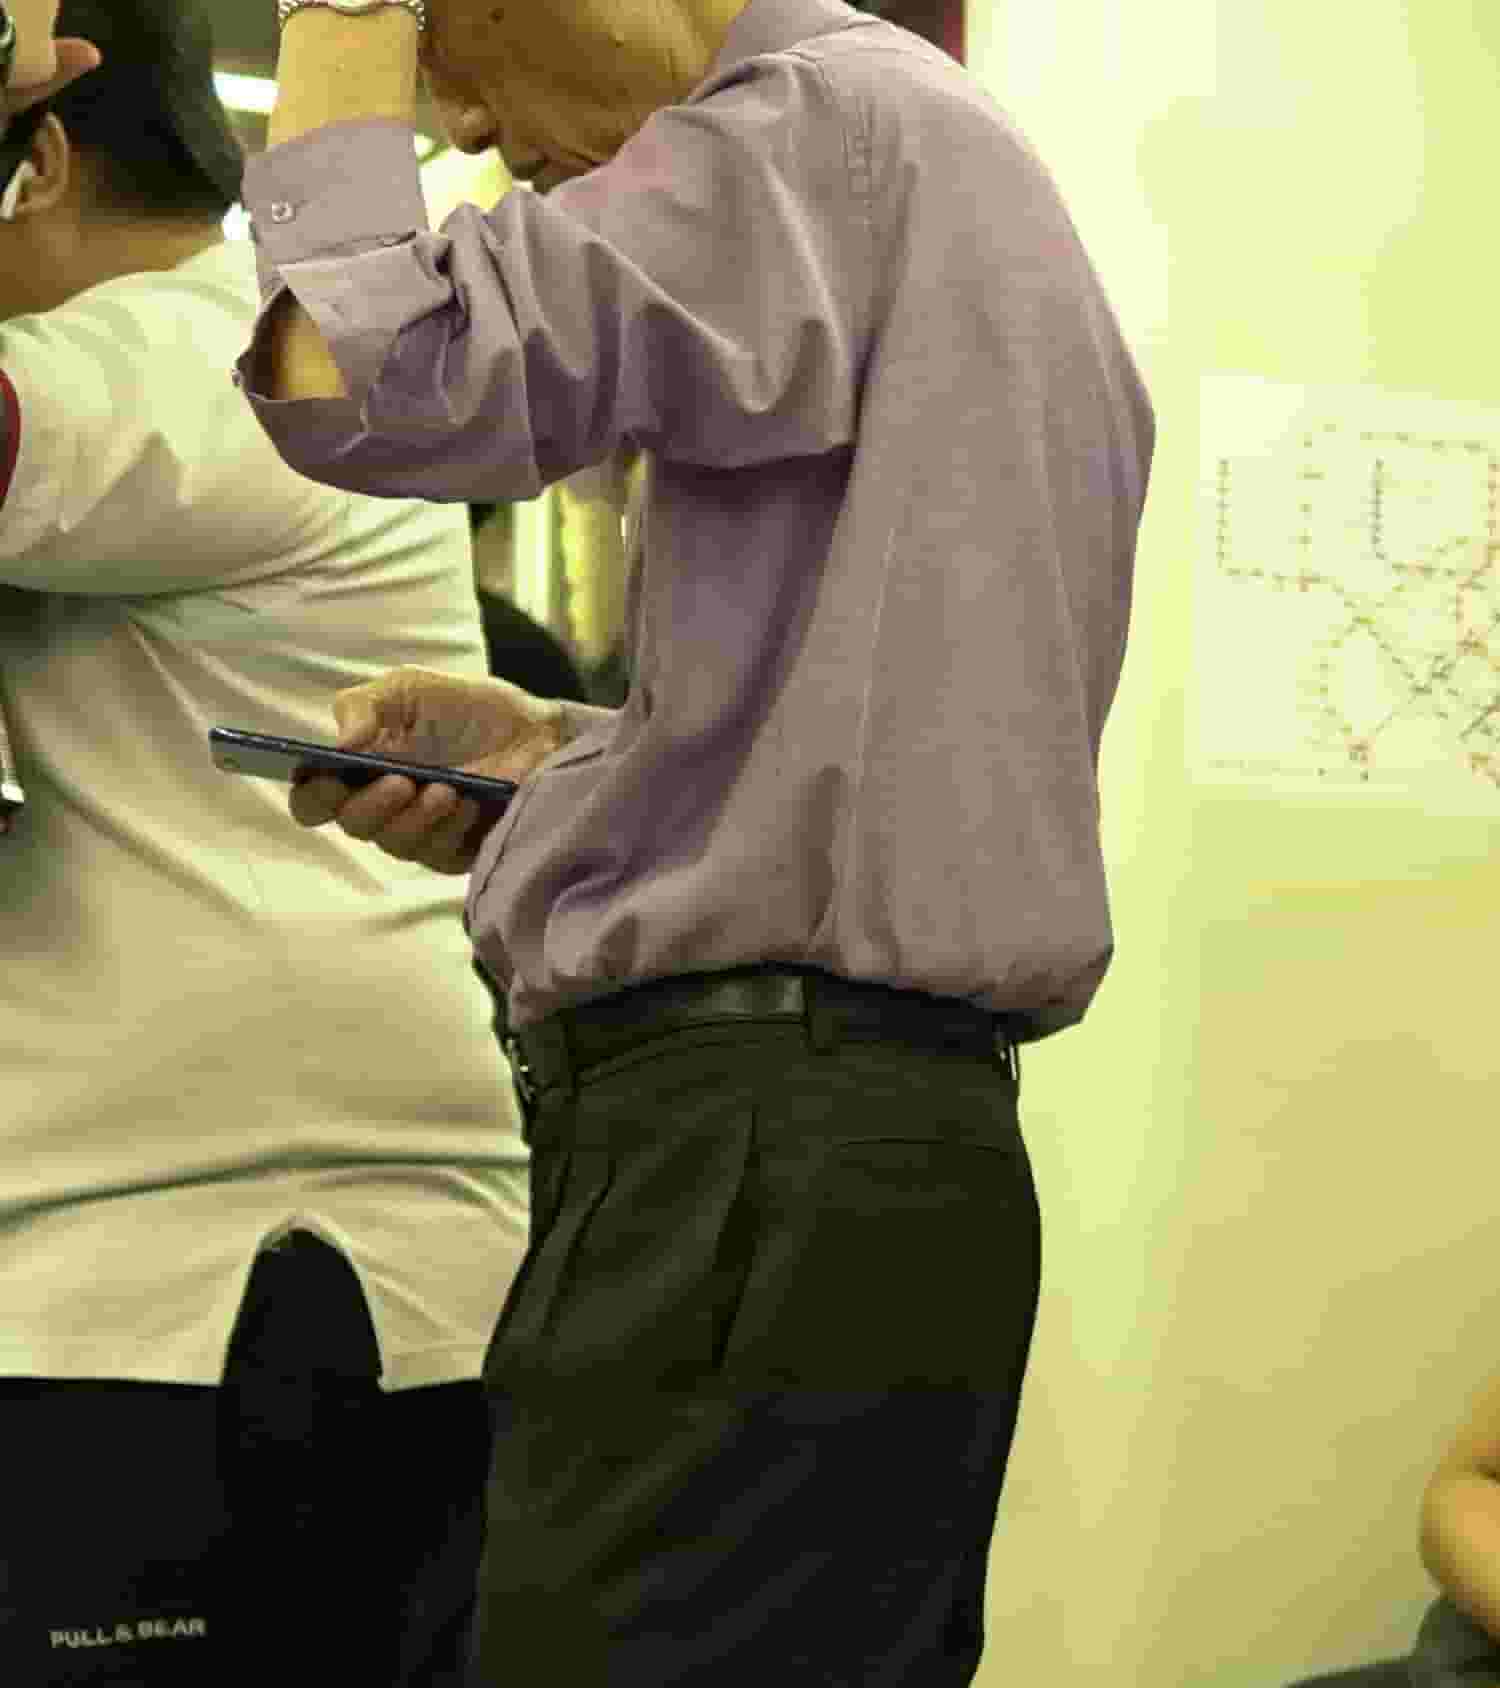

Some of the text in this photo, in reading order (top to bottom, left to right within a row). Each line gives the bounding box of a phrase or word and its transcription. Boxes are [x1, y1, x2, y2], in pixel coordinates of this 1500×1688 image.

[49, 1617, 206, 1649] PULL & BEAR
